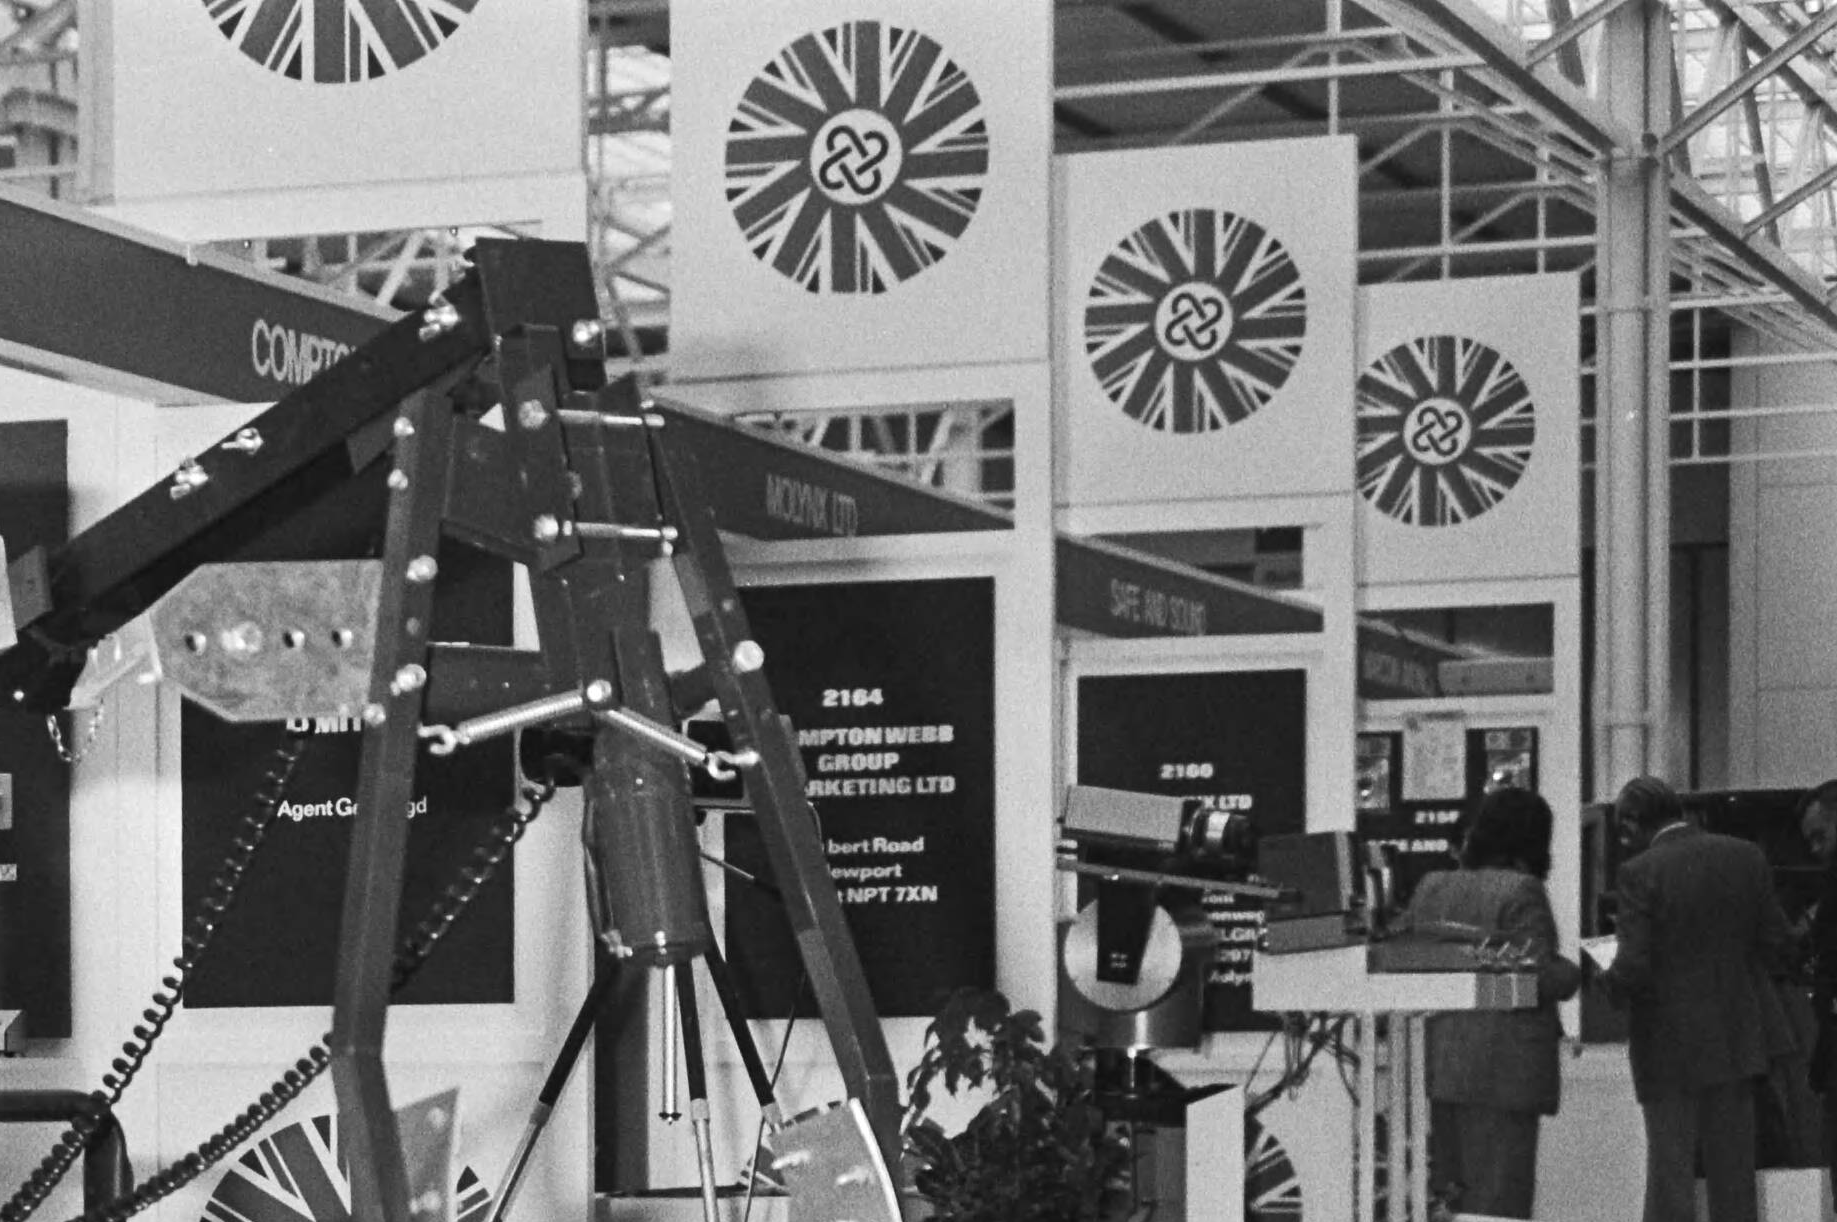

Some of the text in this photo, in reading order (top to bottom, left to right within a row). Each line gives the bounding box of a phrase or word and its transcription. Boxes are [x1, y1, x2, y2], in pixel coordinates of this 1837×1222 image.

[822, 687, 884, 708] 2164
[798, 727, 882, 747] MPTON
[817, 751, 900, 772] GROUP
[805, 775, 956, 797] RKETING LTD
[276, 799, 334, 823] Agent
[826, 862, 902, 883] ewport
